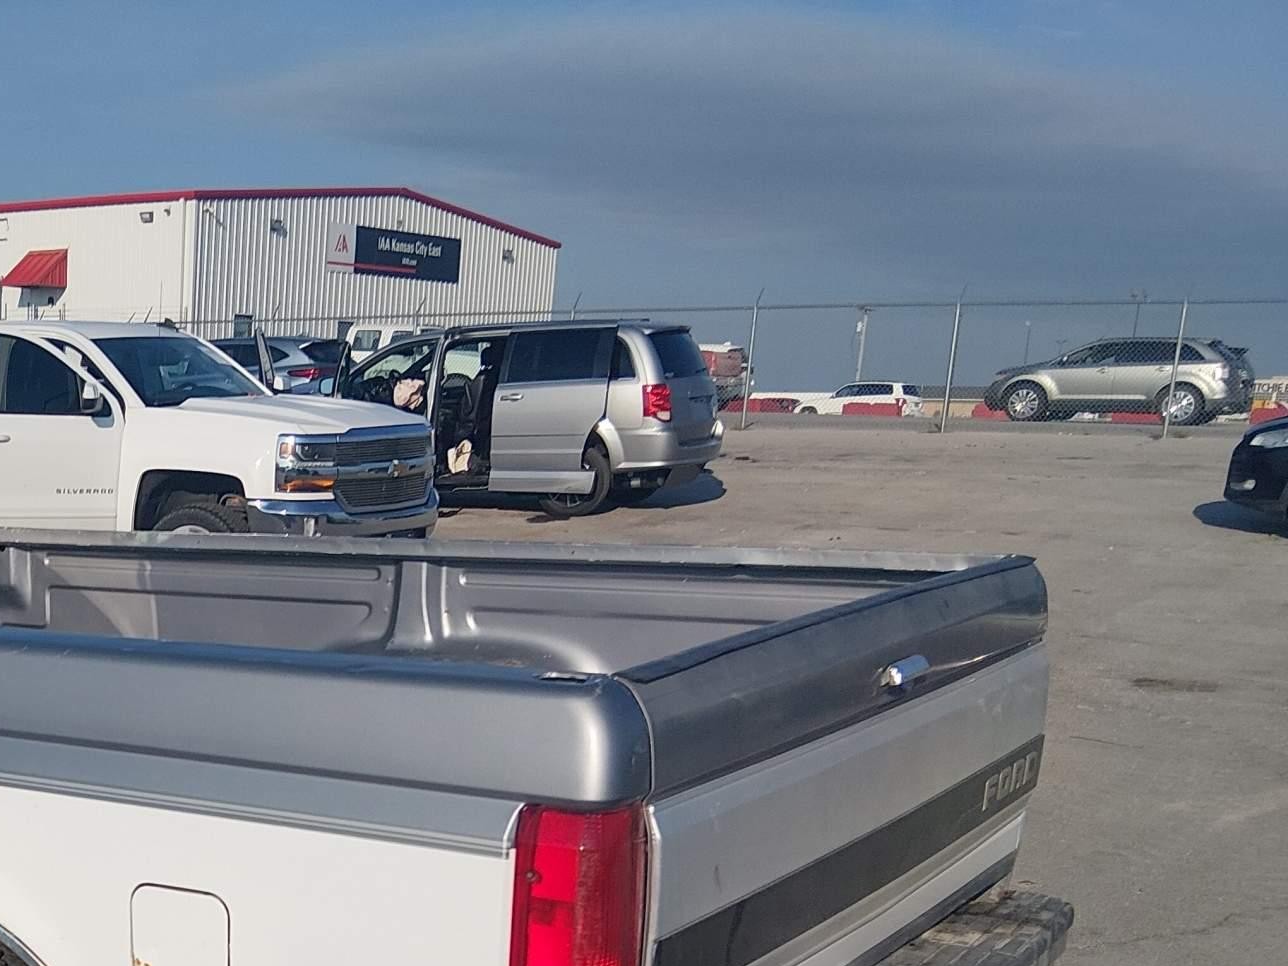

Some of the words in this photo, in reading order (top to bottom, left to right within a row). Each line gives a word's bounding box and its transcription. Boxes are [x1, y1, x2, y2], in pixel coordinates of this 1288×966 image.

[378, 236, 391, 251] IAA
[392, 238, 414, 254] Kansas
[415, 241, 428, 258] City
[428, 242, 442, 258] East
[982, 752, 1039, 812] FORD
